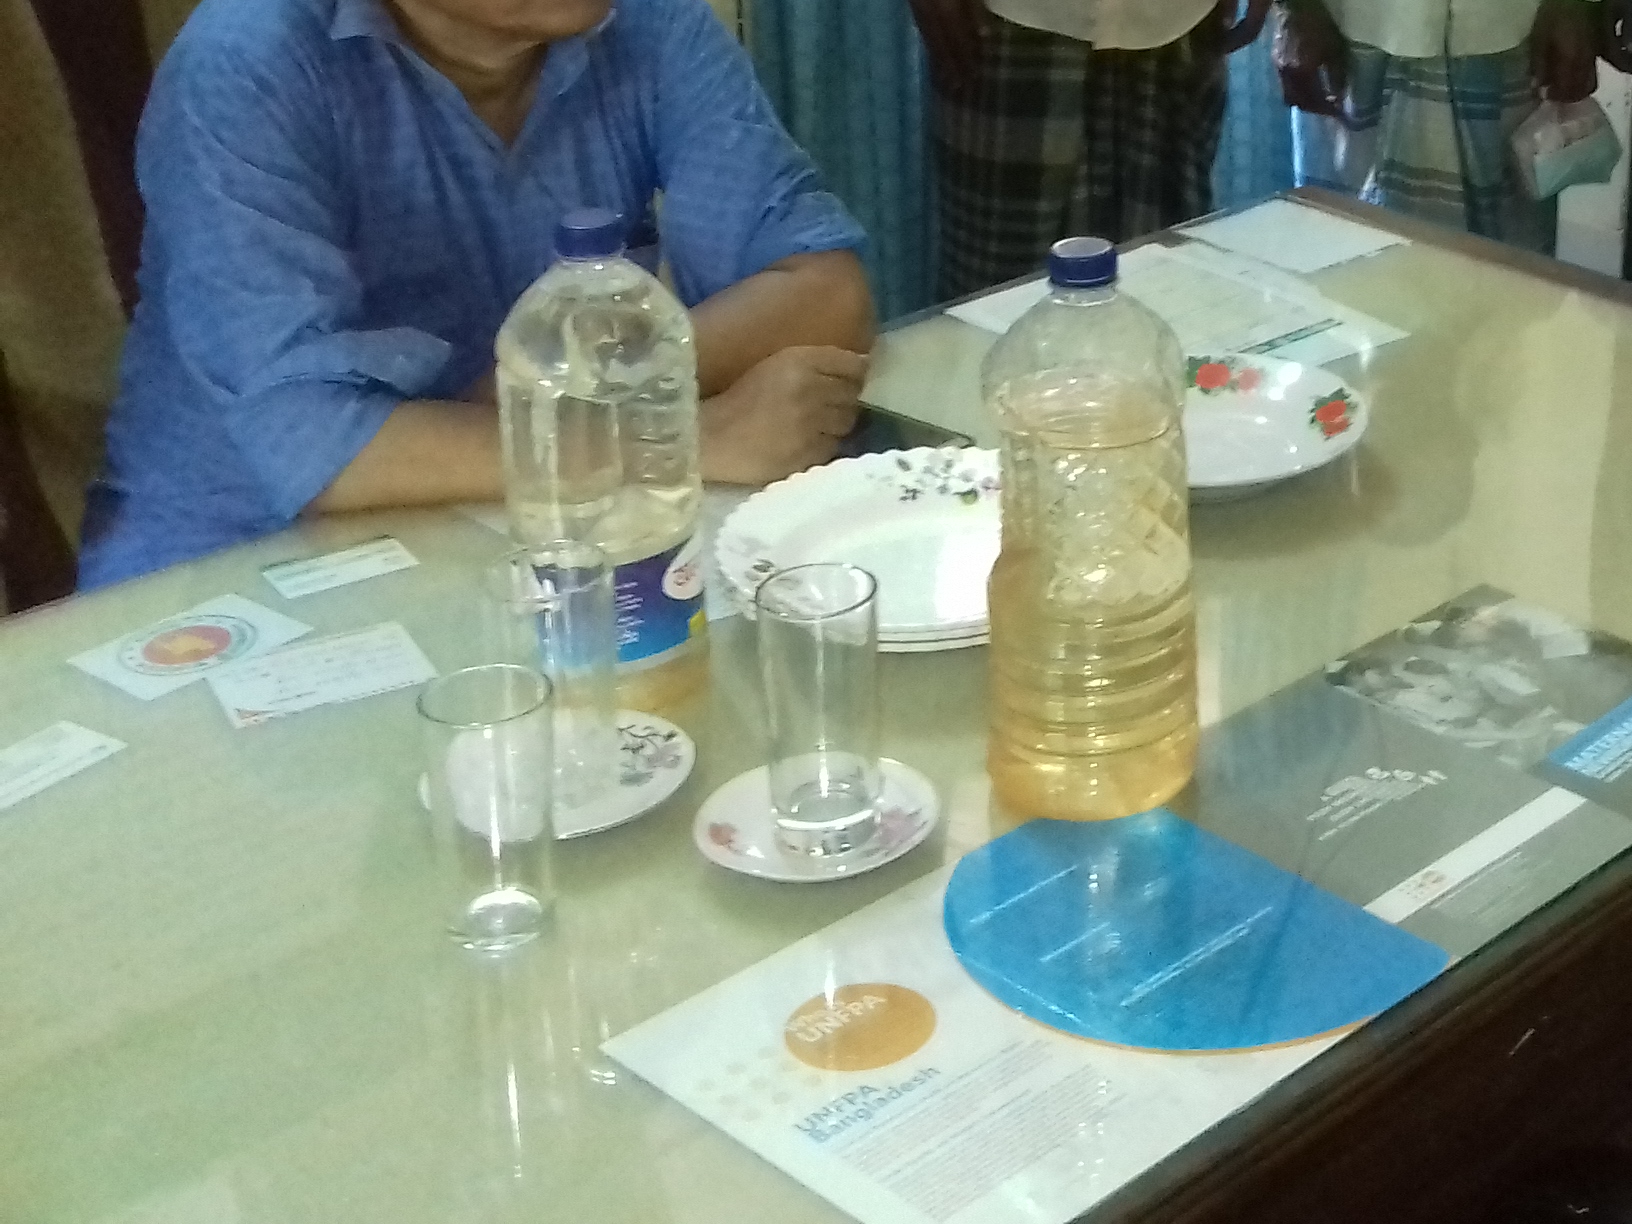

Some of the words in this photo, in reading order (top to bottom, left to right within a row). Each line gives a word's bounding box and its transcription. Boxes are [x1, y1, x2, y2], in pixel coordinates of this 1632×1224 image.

[797, 995, 887, 1043] UNFPA
[794, 1084, 880, 1132] UNFPA
[807, 1067, 942, 1144] Bangladesh
